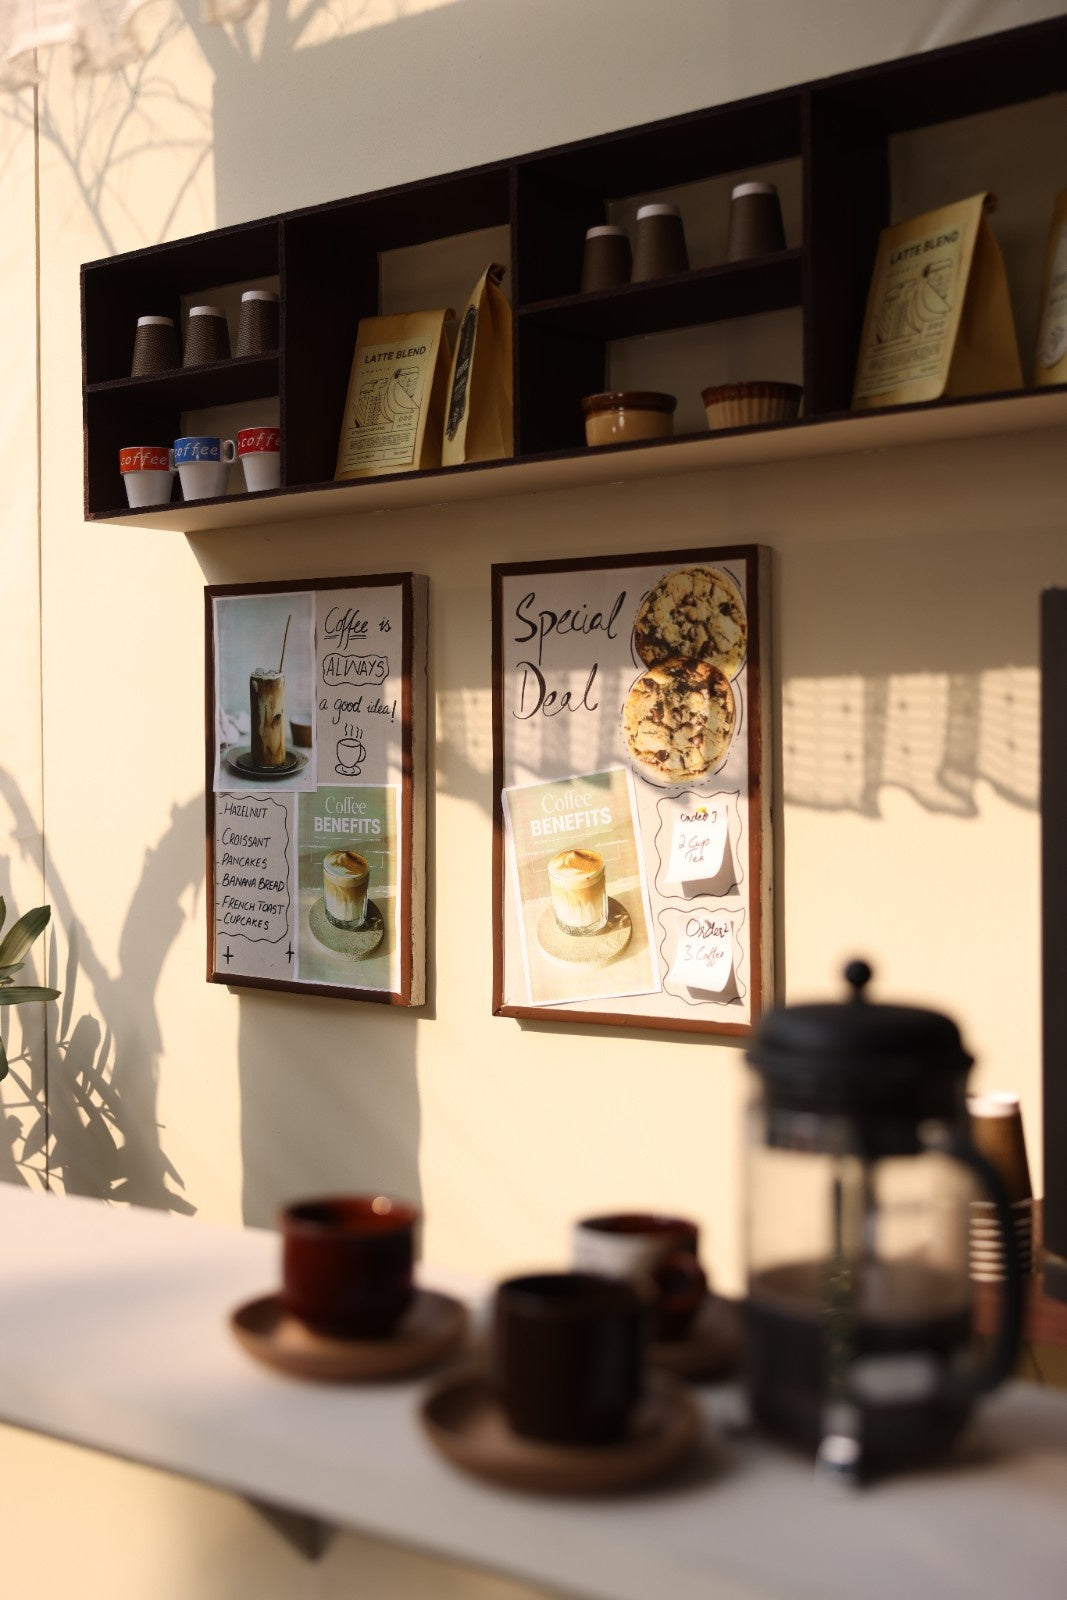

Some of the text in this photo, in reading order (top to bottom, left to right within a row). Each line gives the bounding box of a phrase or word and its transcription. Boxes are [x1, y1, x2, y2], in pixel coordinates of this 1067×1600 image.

[890, 230, 959, 264] LATTE BLEND
[365, 346, 427, 364] LATTE BLEND
[120, 451, 167, 466] coffee
[324, 606, 392, 650] Coffee is
[514, 590, 627, 666] Special
[326, 656, 385, 678] ALWAYS
[512, 662, 599, 720] Deal
[318, 696, 397, 725] a good idea!
[224, 802, 268, 819] HAZELNUT
[325, 796, 367, 815] Coffee
[540, 788, 593, 814] Coffee
[313, 816, 381, 835] BENEFITS
[530, 806, 612, 837] BENEFITS
[222, 827, 271, 849] CROISSANT
[221, 852, 267, 870] PANCAKES
[222, 872, 285, 892] BANANA BREAD
[221, 895, 285, 915] FRENCH TOAST
[223, 911, 270, 931] CUPCAKES
